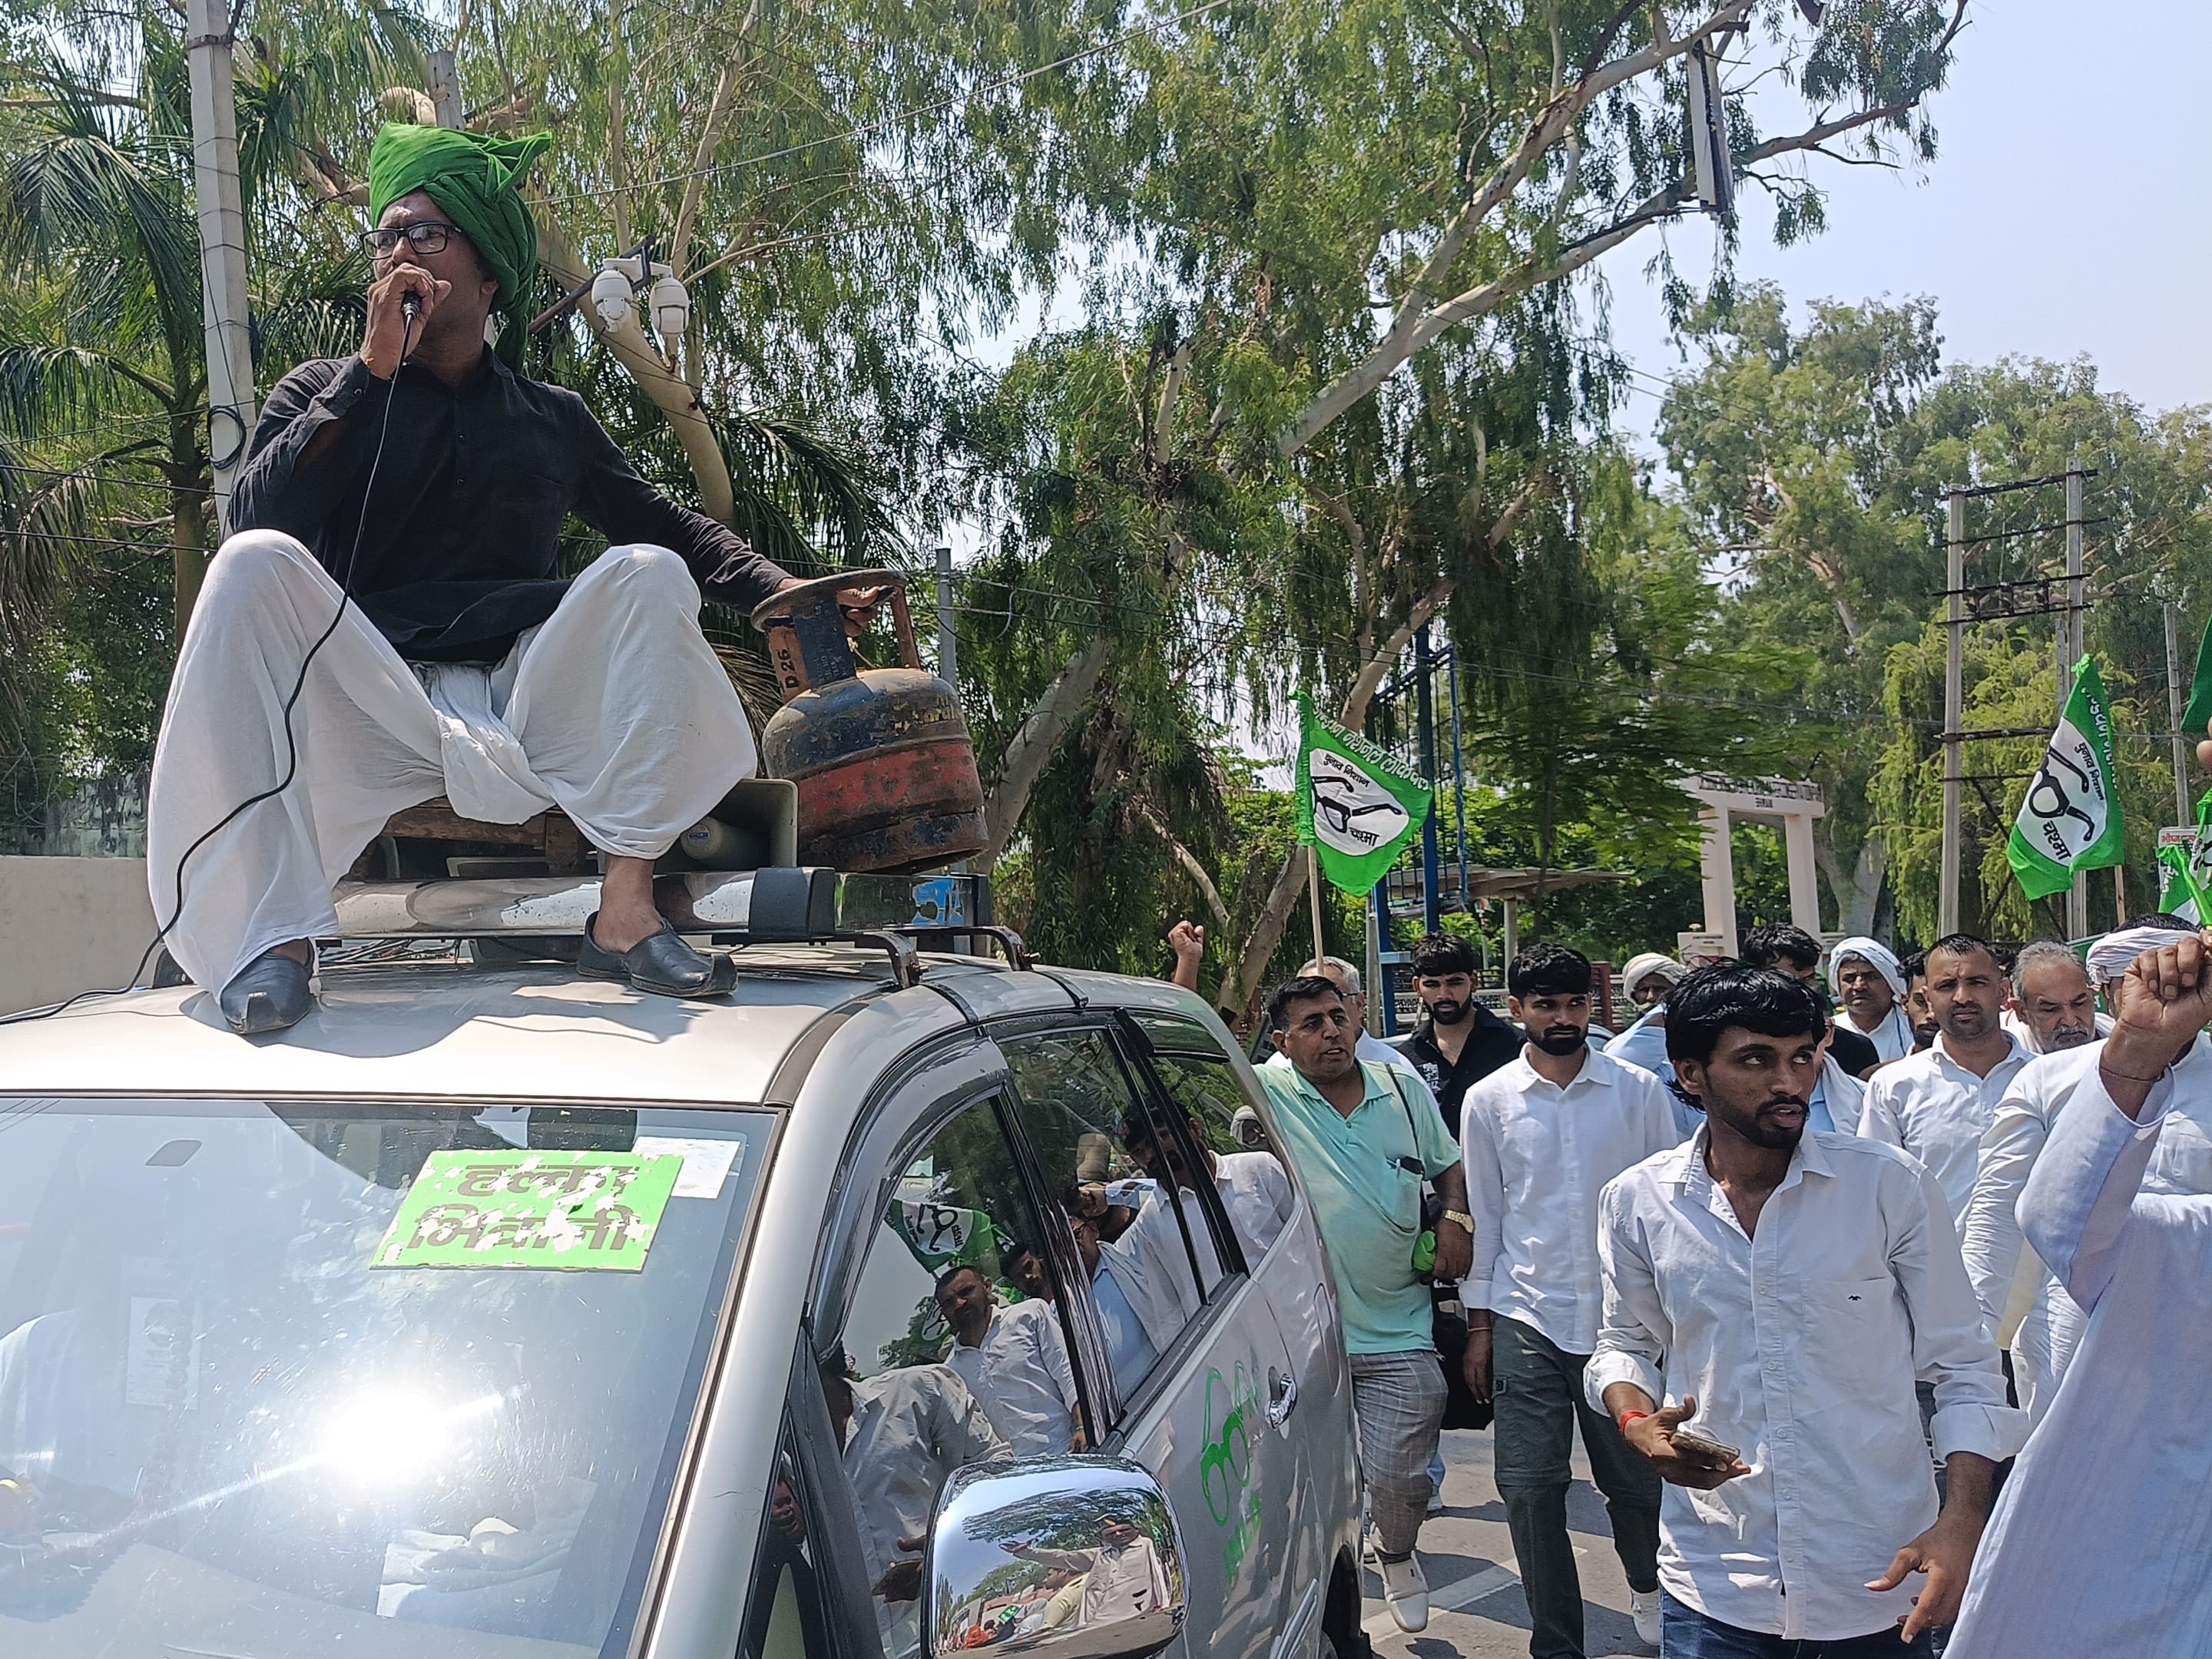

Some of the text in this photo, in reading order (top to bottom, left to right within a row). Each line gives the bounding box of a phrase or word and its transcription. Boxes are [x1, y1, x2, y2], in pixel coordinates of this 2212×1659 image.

[1323, 753, 1371, 787] चुनाव निशान
[2074, 742, 2095, 768] चुनाव
[1349, 826, 1379, 847] चश्मा
[2041, 820, 2072, 861] चश्मा
